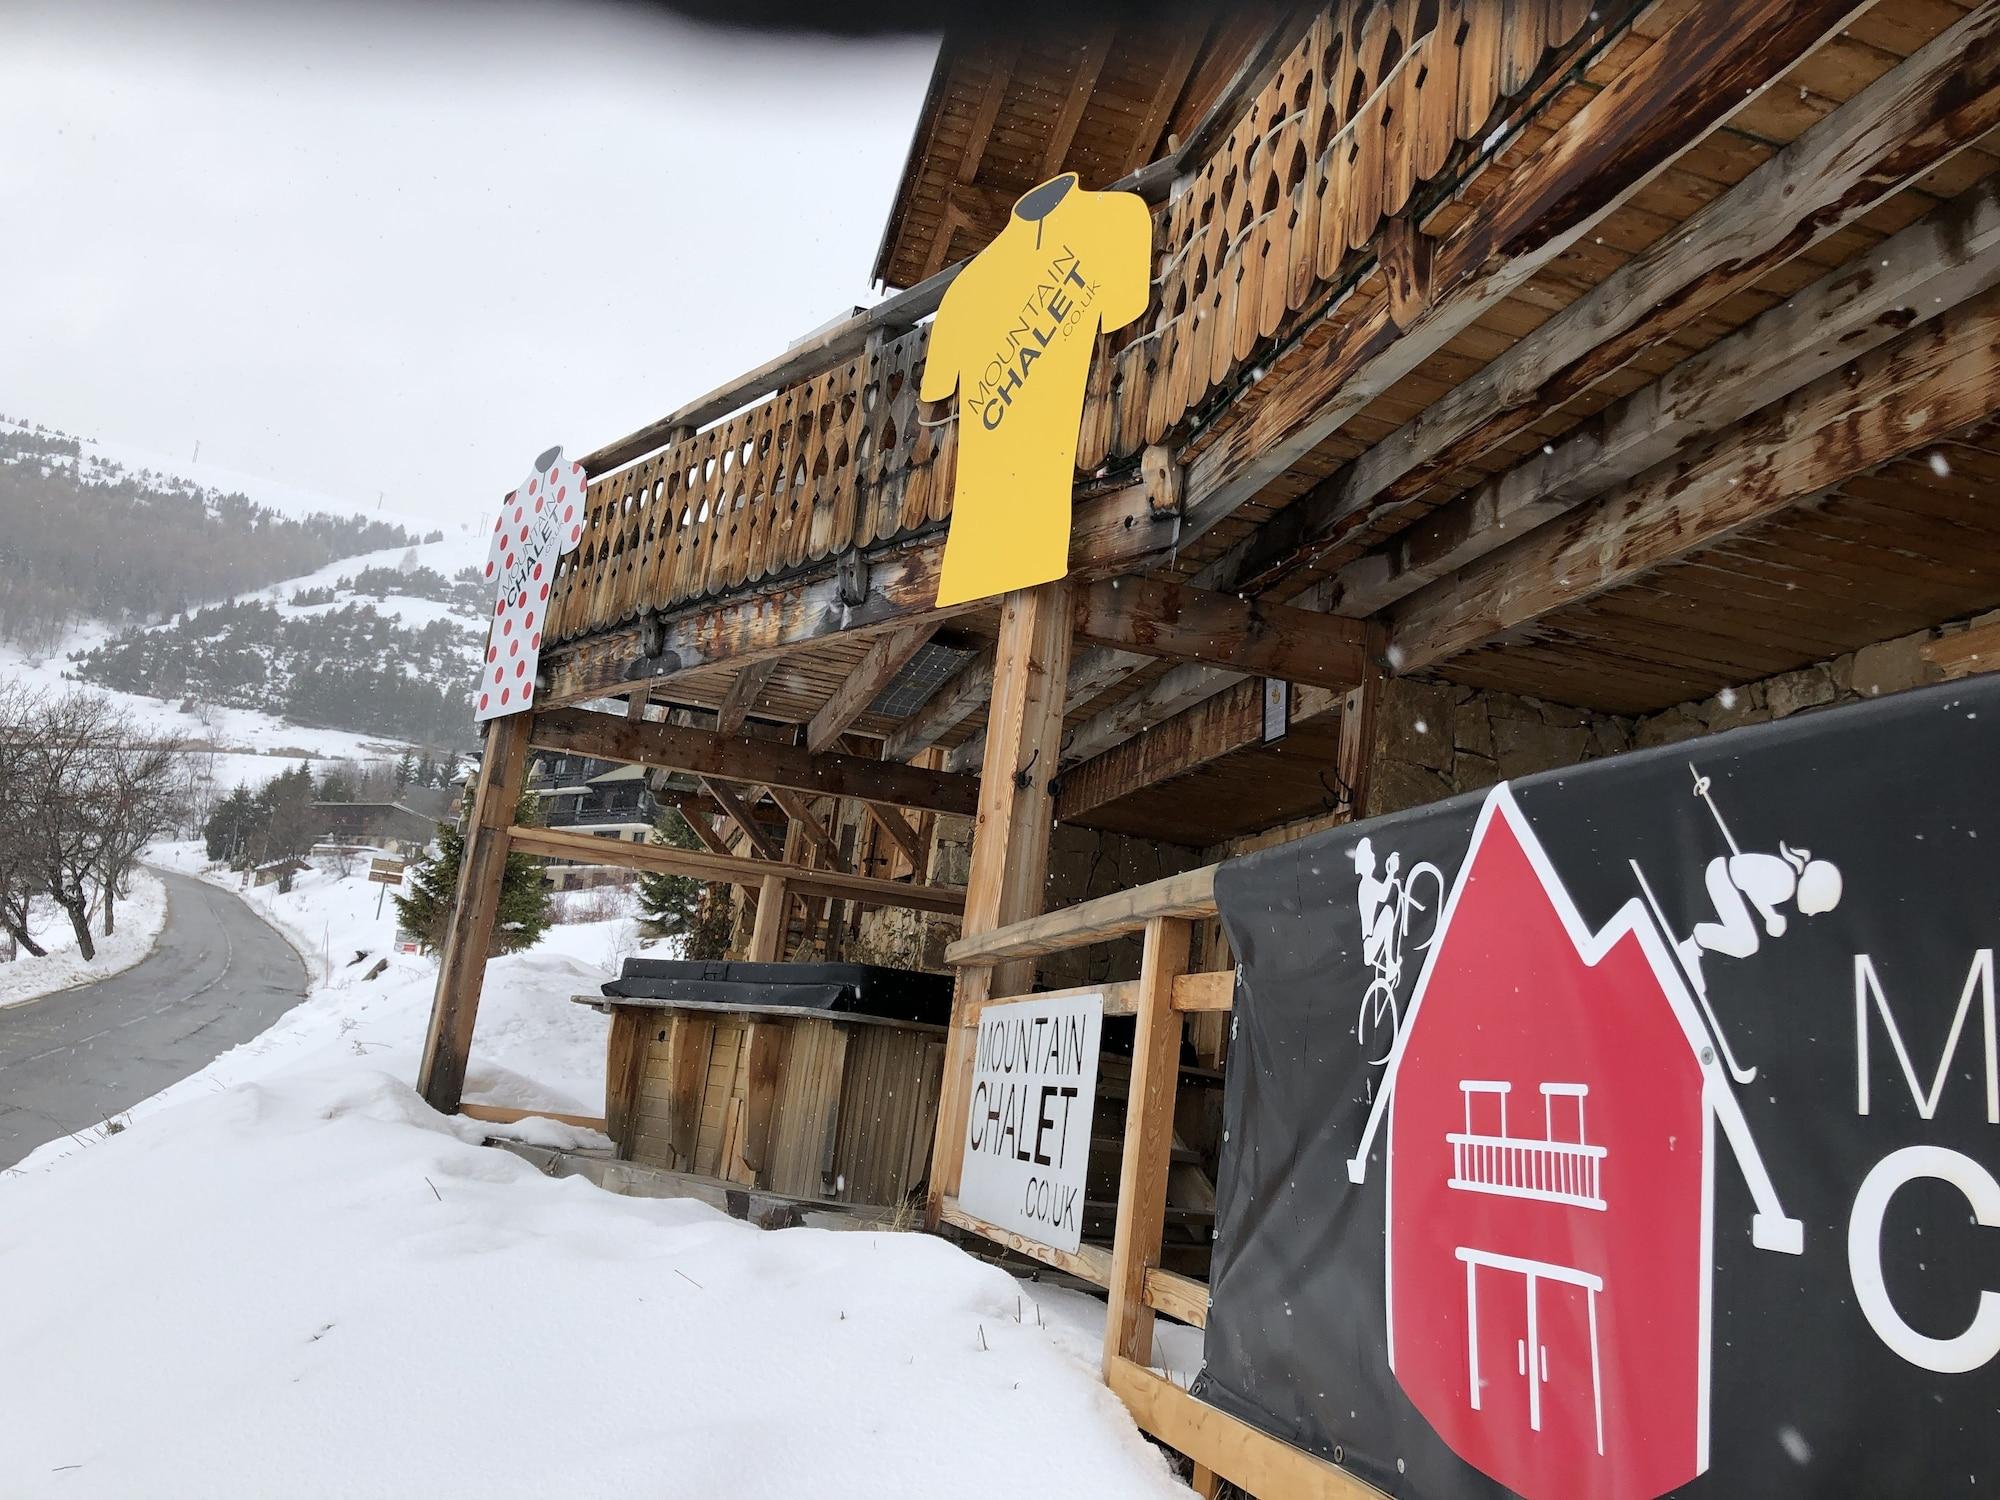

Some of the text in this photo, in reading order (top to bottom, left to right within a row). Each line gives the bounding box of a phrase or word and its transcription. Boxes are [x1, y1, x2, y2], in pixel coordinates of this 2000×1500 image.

[967, 244, 1076, 415] MOUNTAIN
[983, 260, 1086, 431] CHALET
[507, 504, 558, 608] CHALET
[977, 1013, 1087, 1076] MOUNTAIN
[970, 1080, 1078, 1170] CHALET
[1020, 1176, 1078, 1232] .CO.UK
